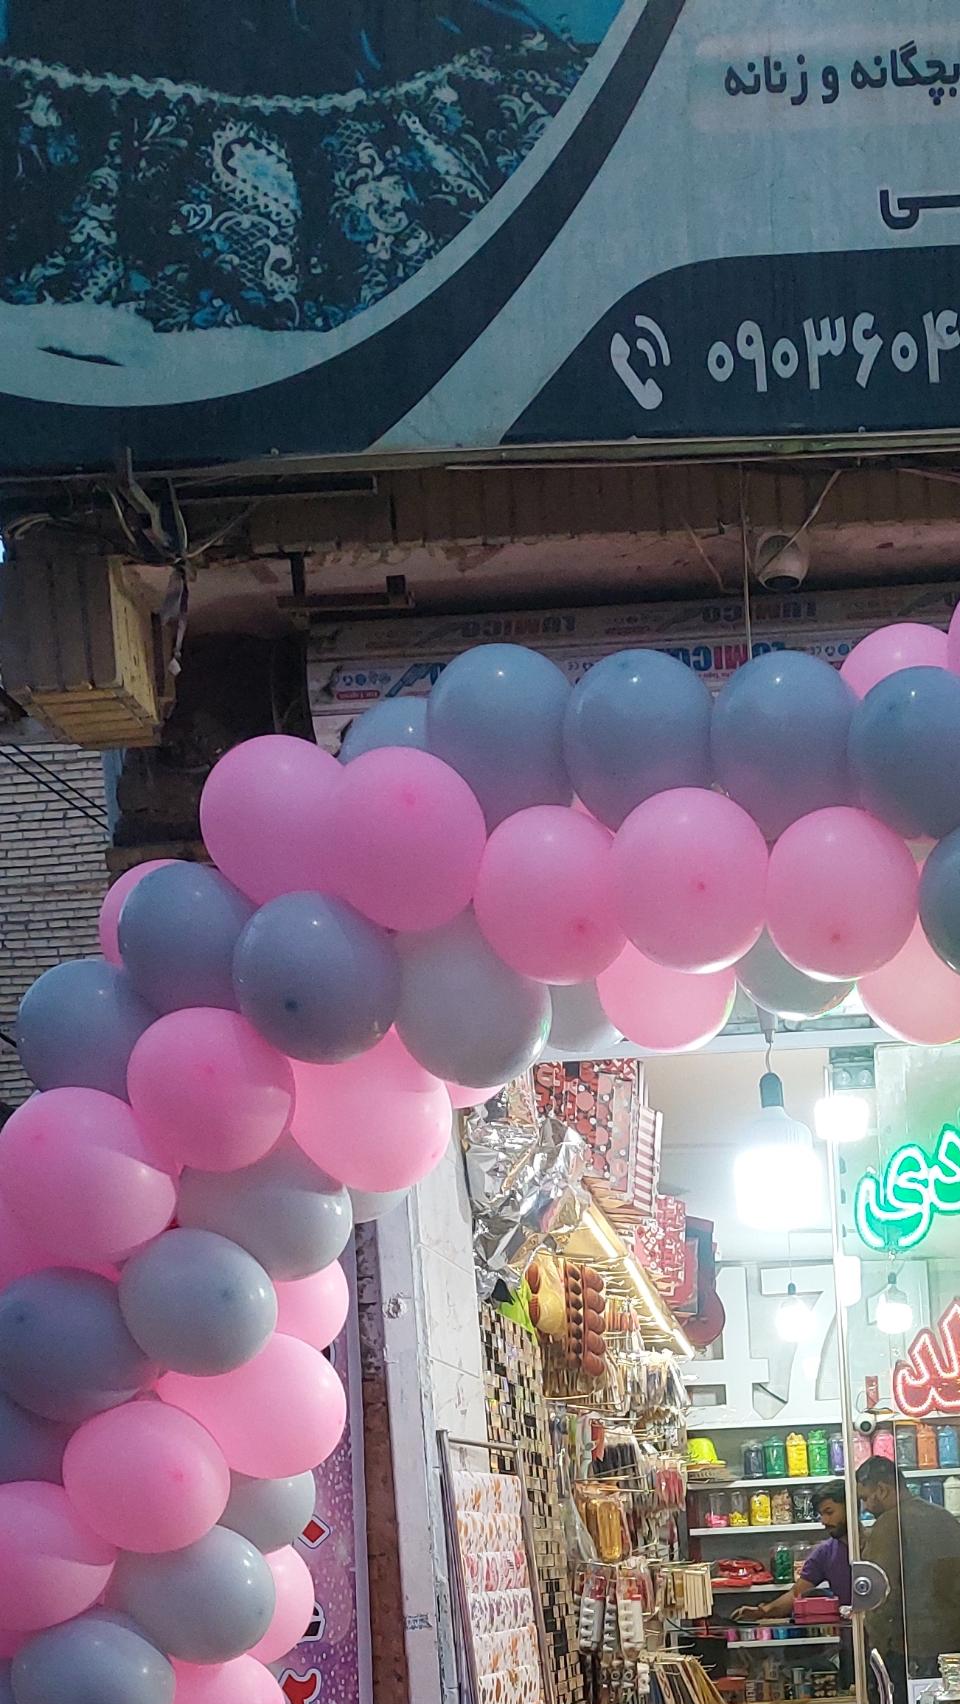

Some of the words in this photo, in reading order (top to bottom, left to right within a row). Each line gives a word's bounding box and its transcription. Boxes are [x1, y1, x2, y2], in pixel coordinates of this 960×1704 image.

[724, 53, 809, 106] زنانه
[821, 64, 840, 104] و
[850, 39, 960, 106] بچگانه
